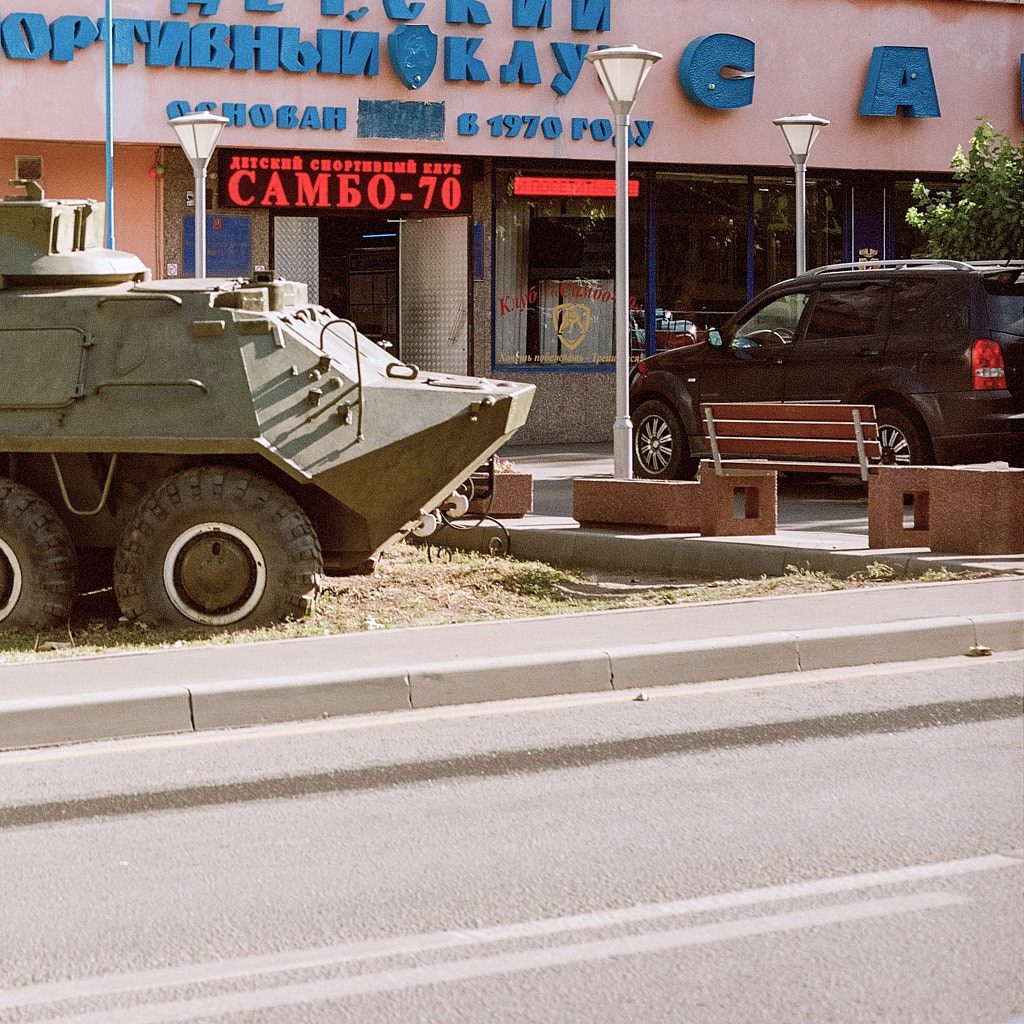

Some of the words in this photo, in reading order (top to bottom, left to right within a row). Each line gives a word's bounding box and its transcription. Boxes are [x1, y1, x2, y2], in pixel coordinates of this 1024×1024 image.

[443, 36, 610, 97] КЛУ
[457, 112, 480, 136] В
[487, 114, 563, 139] 1970
[230, 156, 303, 171] ДЕТСКИЙ
[310, 159, 417, 174] СПОРТИВНЫЙ
[423, 163, 462, 175] КЛУБ
[228, 169, 462, 210] САМБО-70
[498, 285, 538, 318] Клуб
